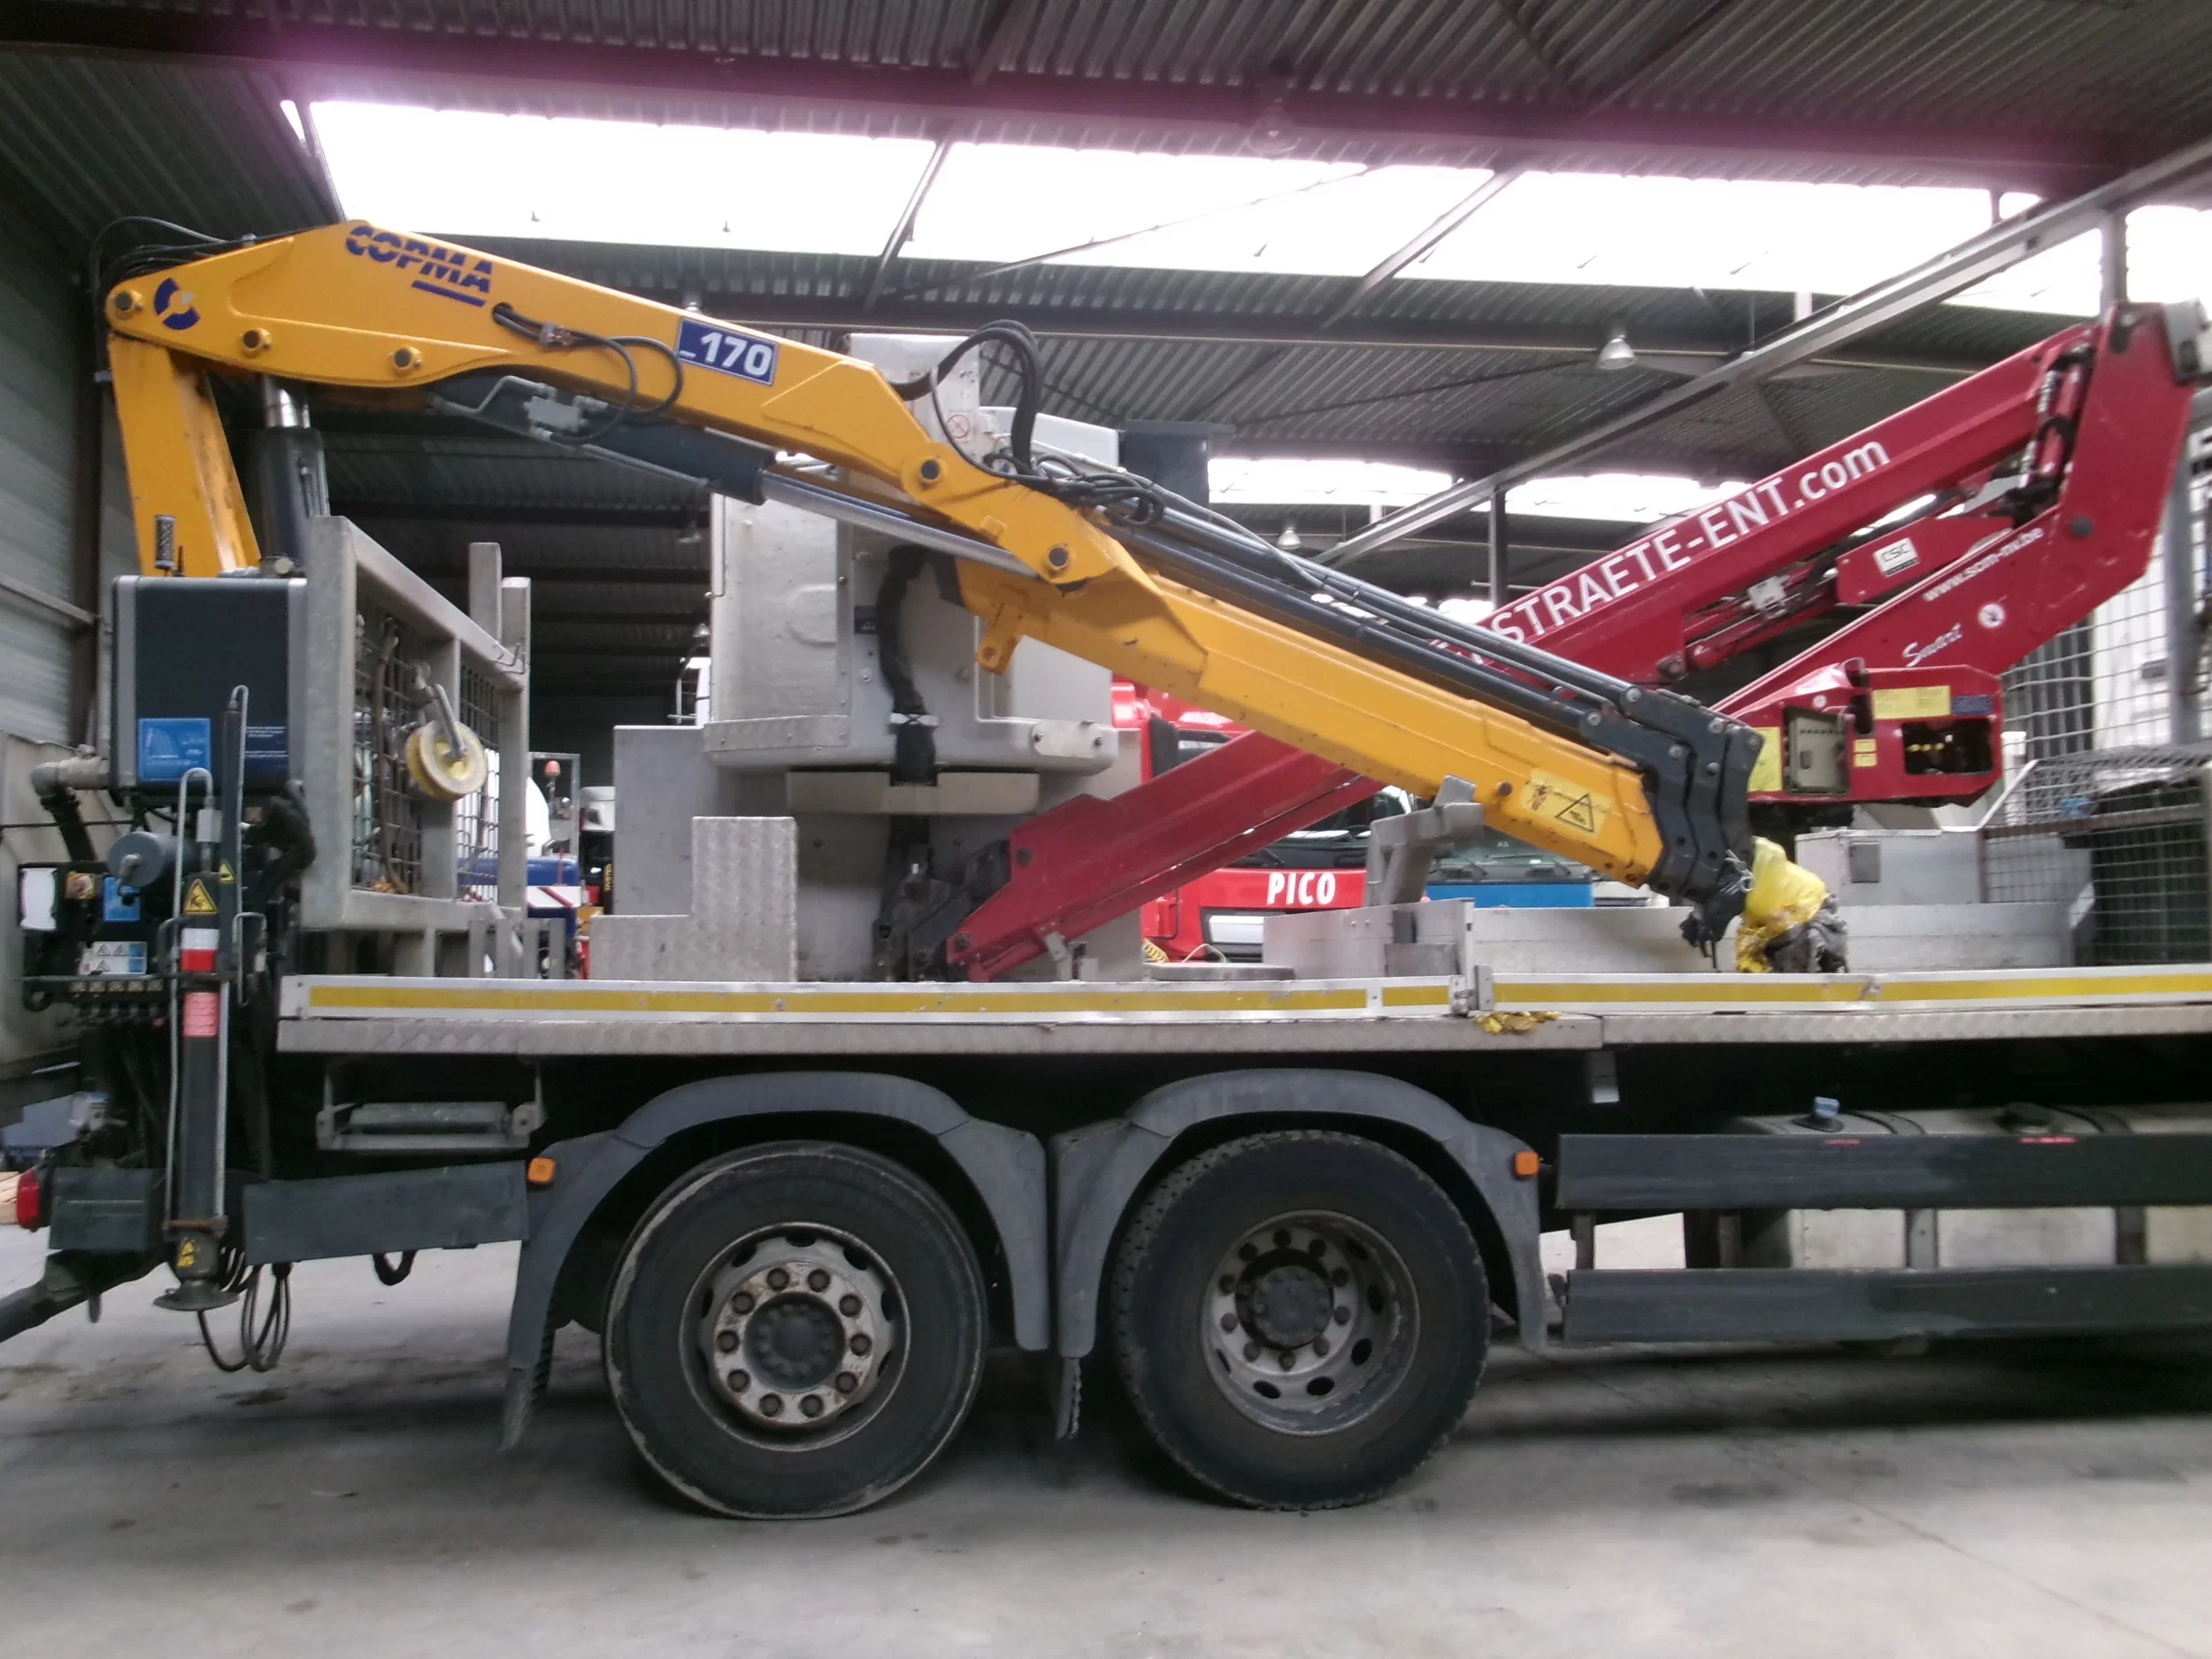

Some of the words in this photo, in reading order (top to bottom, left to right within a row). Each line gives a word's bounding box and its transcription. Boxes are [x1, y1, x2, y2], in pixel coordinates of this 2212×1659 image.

[346, 226, 493, 294] COPMA
[1429, 440, 1891, 664] STRAETE-ENT.com
[1266, 872, 1336, 905] PICO
